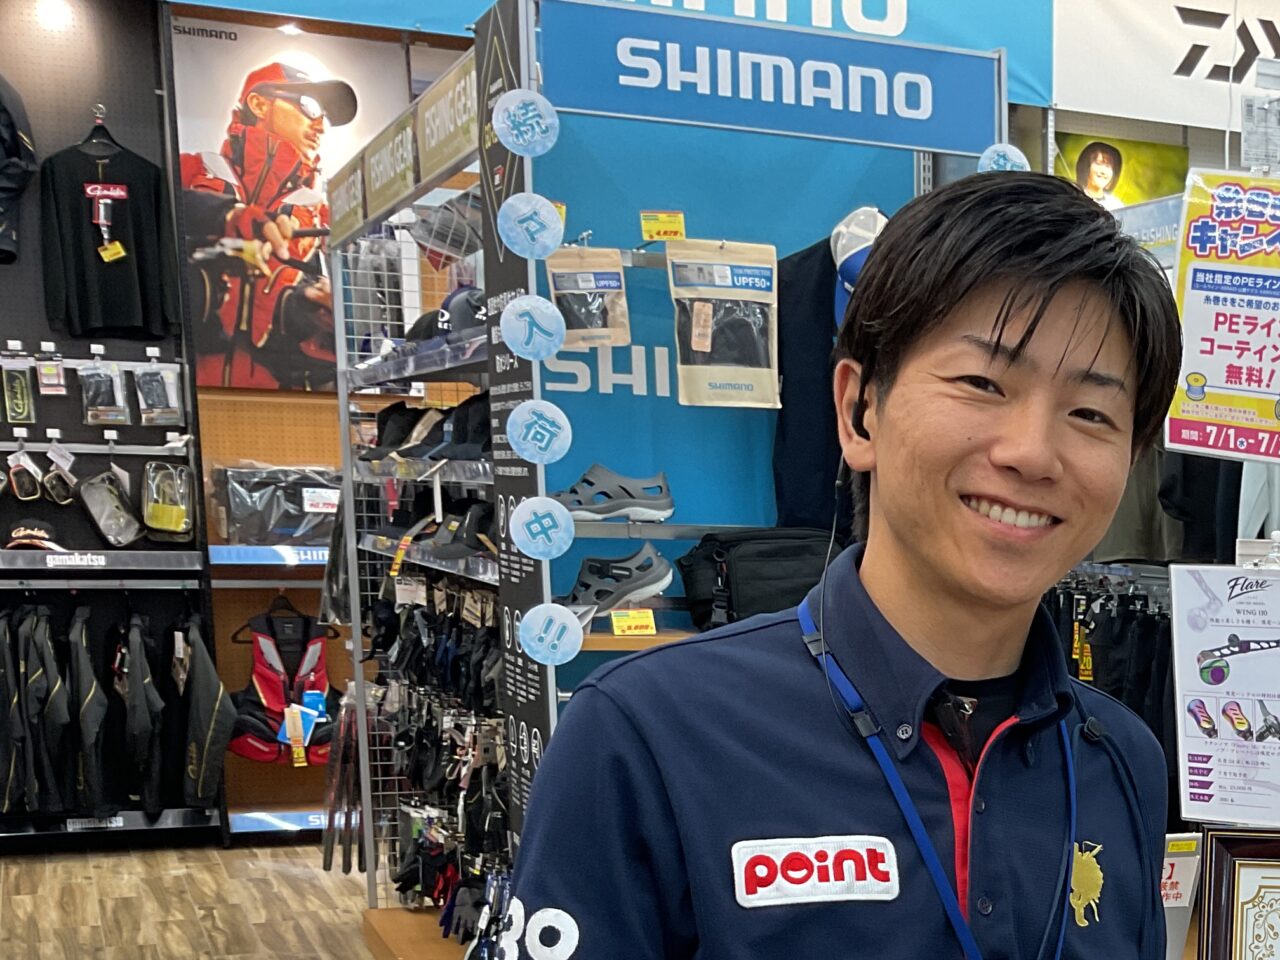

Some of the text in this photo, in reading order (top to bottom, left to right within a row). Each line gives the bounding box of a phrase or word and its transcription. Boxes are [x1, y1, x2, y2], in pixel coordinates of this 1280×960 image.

[172, 23, 238, 42] SHIMANO
[616, 37, 933, 121] SHIMANO
[734, 275, 771, 288] UPF50+
[708, 382, 754, 392] SHIMANO
[46, 552, 106, 567] gamakatsu
[1227, 576, 1273, 601] Flare
[1235, 608, 1256, 616] WING
[744, 847, 891, 896] point
